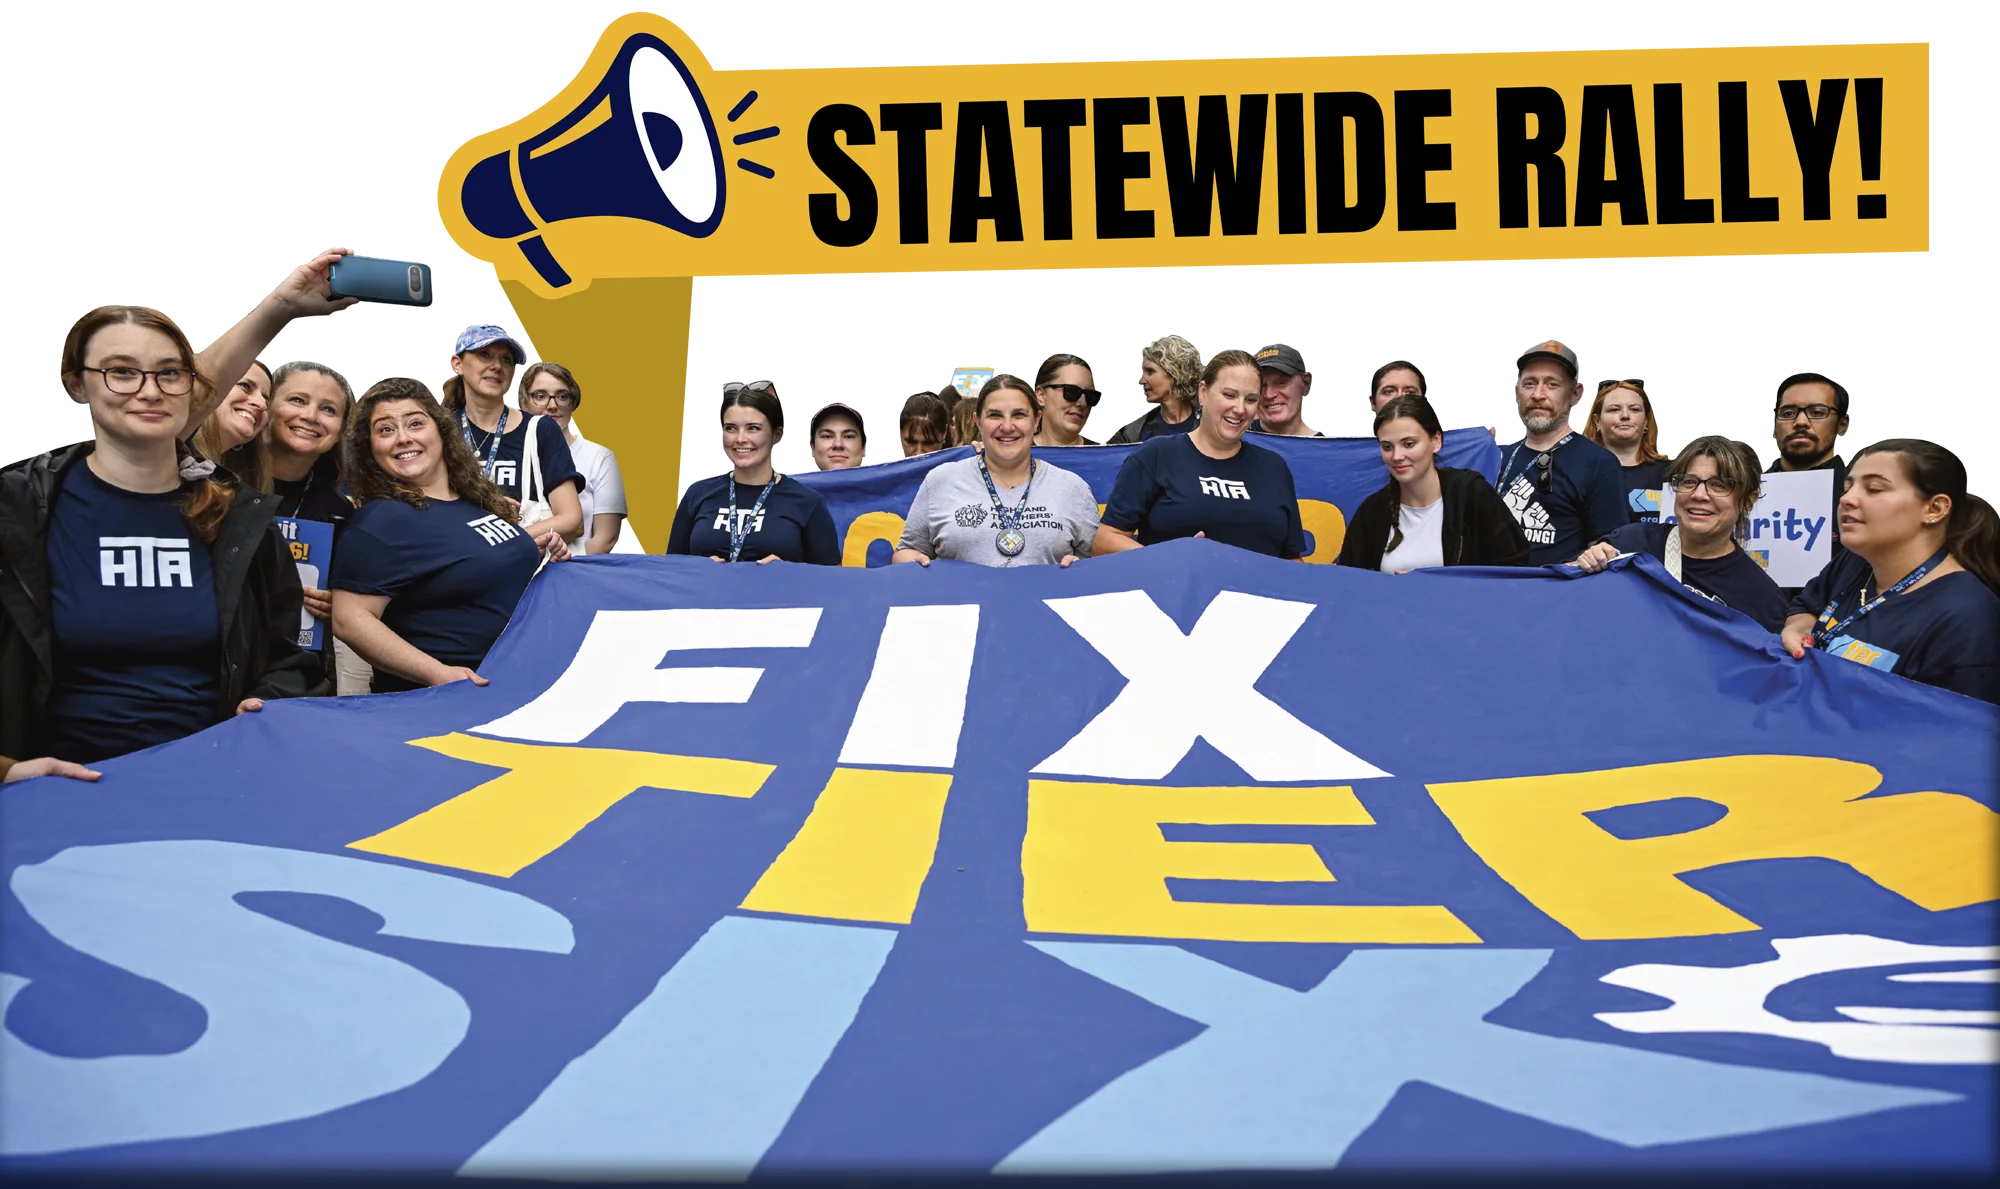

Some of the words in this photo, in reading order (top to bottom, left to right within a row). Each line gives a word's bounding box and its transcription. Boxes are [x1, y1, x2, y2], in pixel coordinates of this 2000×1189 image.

[479, 460, 517, 486] TA
[1199, 476, 1251, 500] HTA
[466, 513, 520, 547] HTA
[713, 508, 766, 535] HTA
[99, 536, 193, 587] HTA
[289, 541, 309, 561] 6!
[467, 590, 1393, 781] FIX
[350, 733, 2000, 943] TIER
[0, 840, 1967, 1177] SIX
